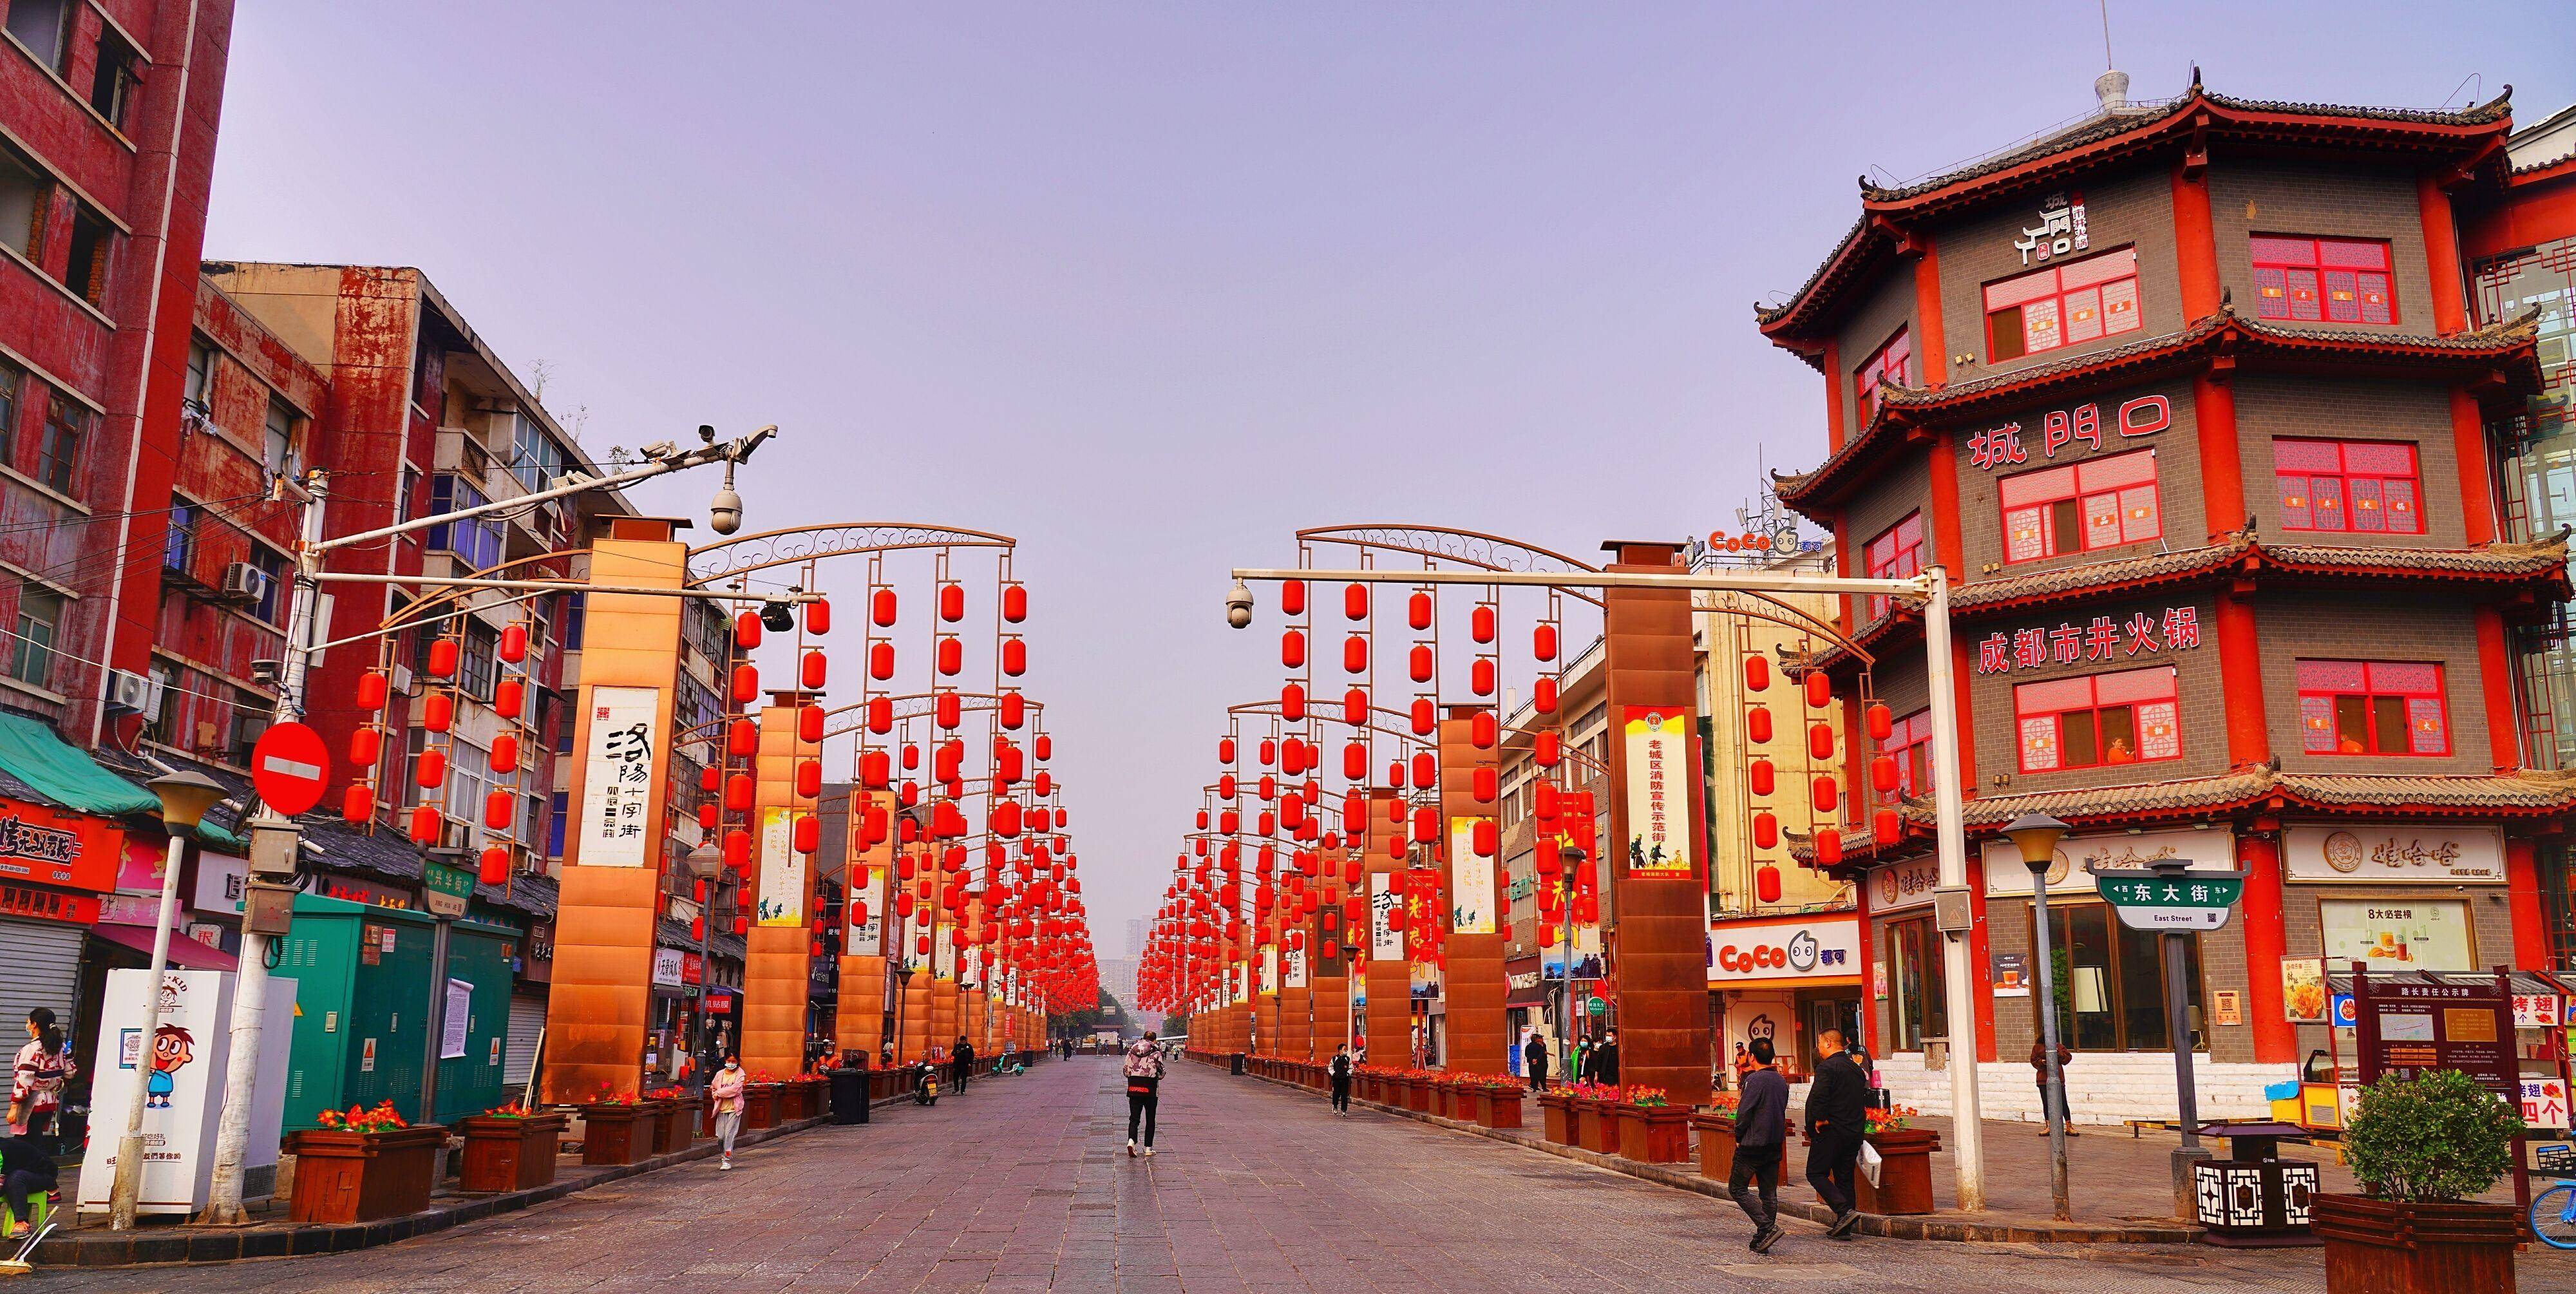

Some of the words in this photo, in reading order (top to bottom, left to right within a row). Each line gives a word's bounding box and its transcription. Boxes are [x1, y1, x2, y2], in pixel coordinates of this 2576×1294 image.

[2072, 193, 2088, 250] 市井火锅
[1968, 394, 2171, 470] 城門口
[2324, 499, 2331, 508] 井
[2363, 500, 2372, 509] 火
[1801, 540, 1823, 552] 都可
[1978, 605, 2200, 674] 成都市井火锅
[2315, 719, 2322, 728] 市
[2423, 721, 2432, 730] 火
[1649, 739, 1667, 842] 老城区消防宣传示范街
[2134, 883, 2208, 902] 东大街
[2368, 909, 2412, 920] 8大必尝榜
[198, 930, 214, 945] 银
[1821, 949, 1846, 966] 都可
[2401, 987, 2470, 996] 路长责任公示牌
[704, 1000, 730, 1009] 机贴膜
